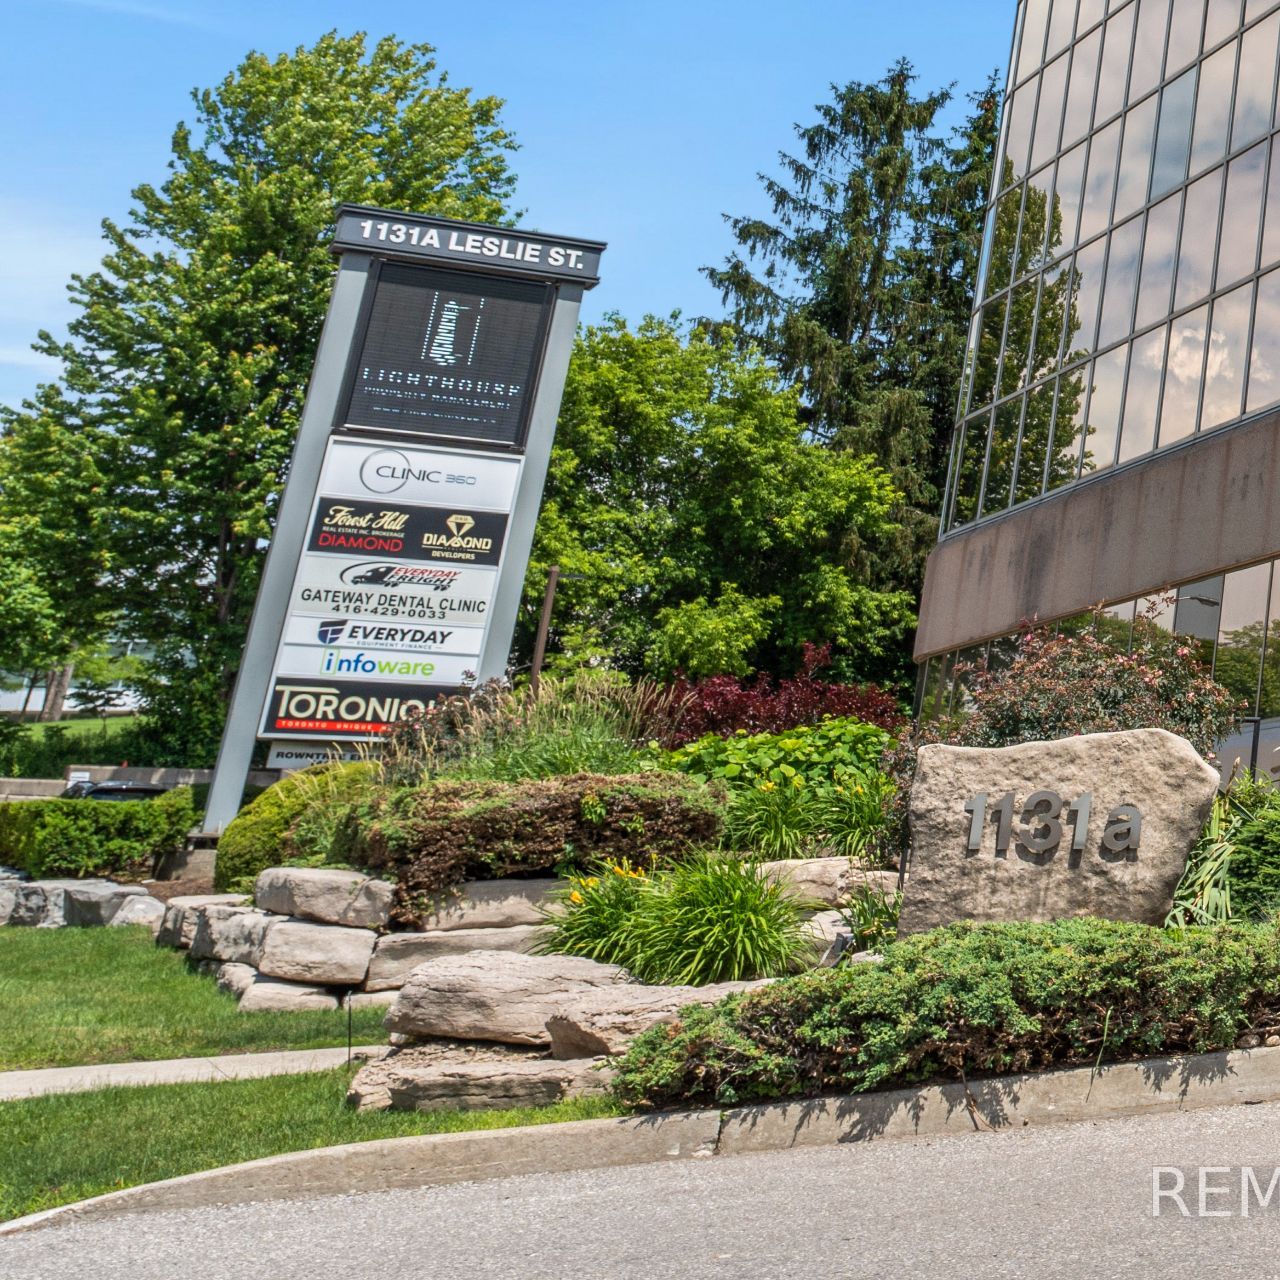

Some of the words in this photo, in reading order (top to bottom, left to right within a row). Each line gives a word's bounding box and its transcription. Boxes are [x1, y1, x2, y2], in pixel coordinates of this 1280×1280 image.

[361, 220, 440, 248] 1131A
[448, 232, 542, 263] LESLIE
[548, 247, 583, 269] ST.
[376, 465, 442, 483] CLINIC
[445, 474, 477, 485] 360
[324, 505, 374, 527] Forest
[372, 511, 410, 530] Hill
[318, 532, 404, 552] DIAMOND
[371, 530, 405, 538] BROKERAGE
[422, 533, 493, 550] DIAMOND
[431, 550, 476, 560] DEVELOPERS
[387, 575, 457, 585] FREIGHT
[394, 567, 462, 578] EVERYDAY
[301, 588, 374, 606] GATEWAY
[377, 594, 433, 610] DENTAL
[439, 598, 487, 613] CLINIC
[348, 625, 454, 644] EVERYDAY
[356, 641, 399, 649] EQUIPMENT
[401, 643, 432, 651] FINANCE
[325, 652, 435, 676] infoware
[275, 685, 464, 723] TORONIQ
[281, 720, 328, 728] TORONTO
[336, 722, 373, 730] UNIQUE
[965, 790, 1142, 853] 1131a
